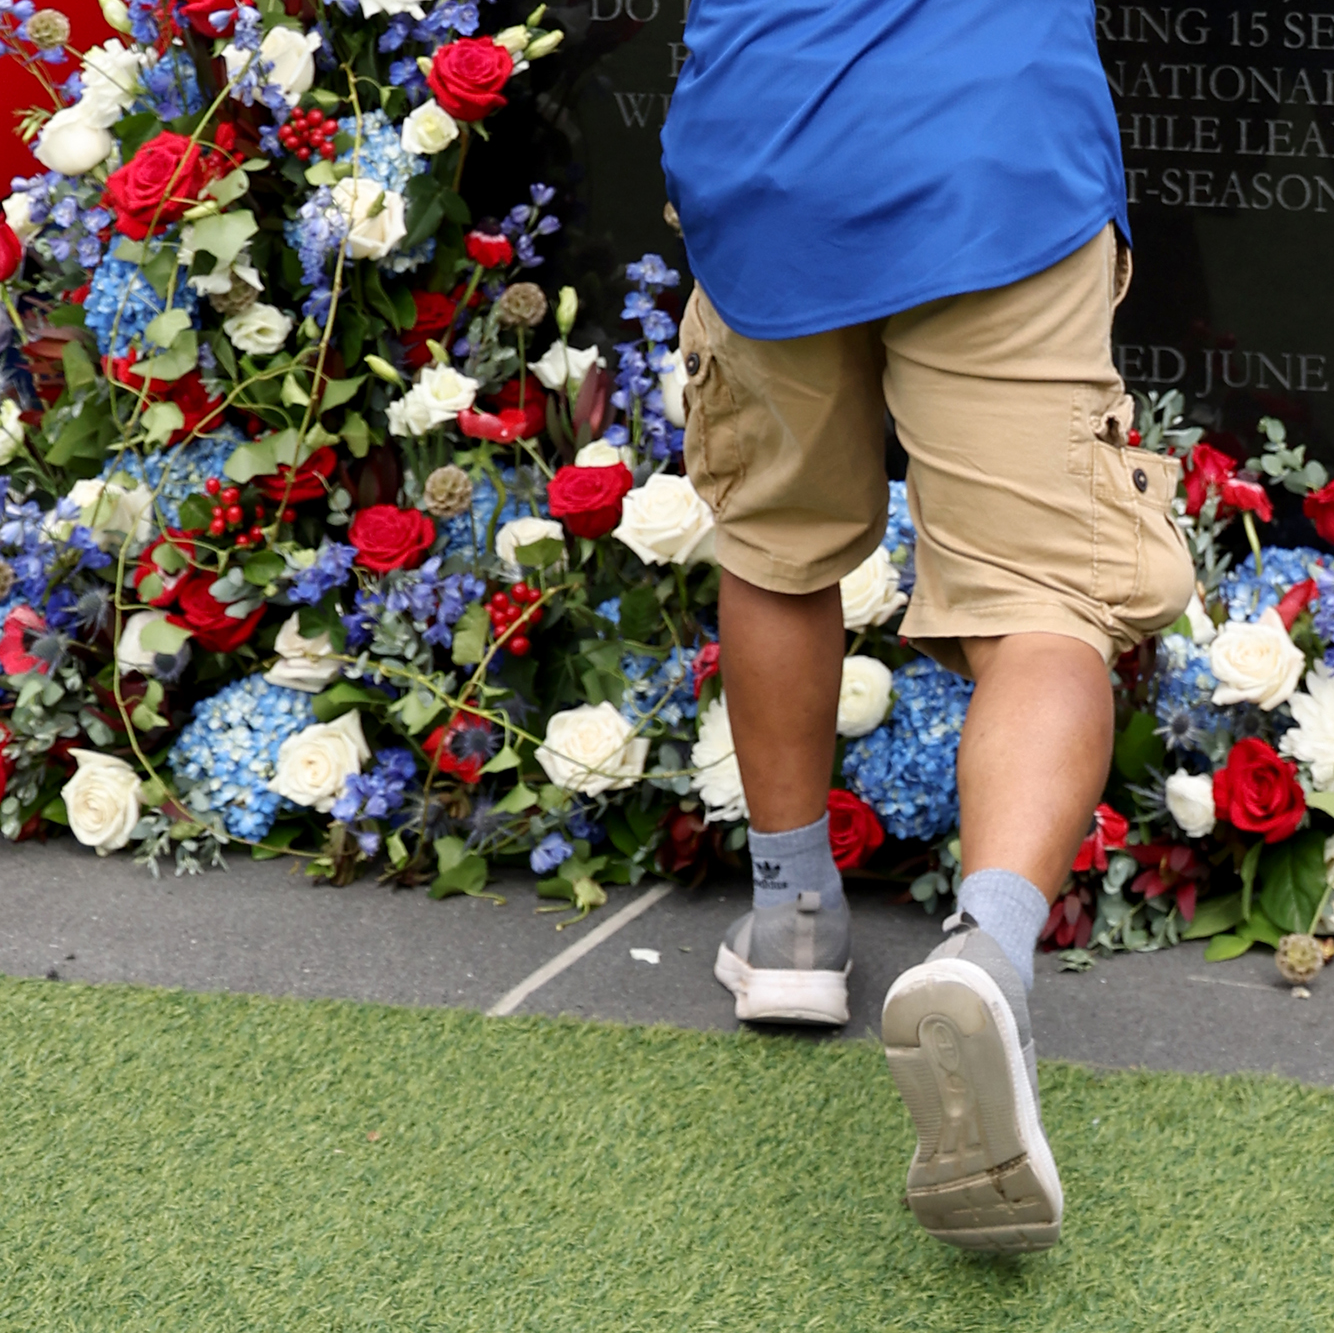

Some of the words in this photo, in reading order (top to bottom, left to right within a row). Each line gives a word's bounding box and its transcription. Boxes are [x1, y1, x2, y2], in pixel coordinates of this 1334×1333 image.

[1095, 5, 1211, 45] RING
[1227, 11, 1271, 49] 15
[1119, 113, 1222, 154] HILE
[1195, 348, 1331, 399] JUNE
